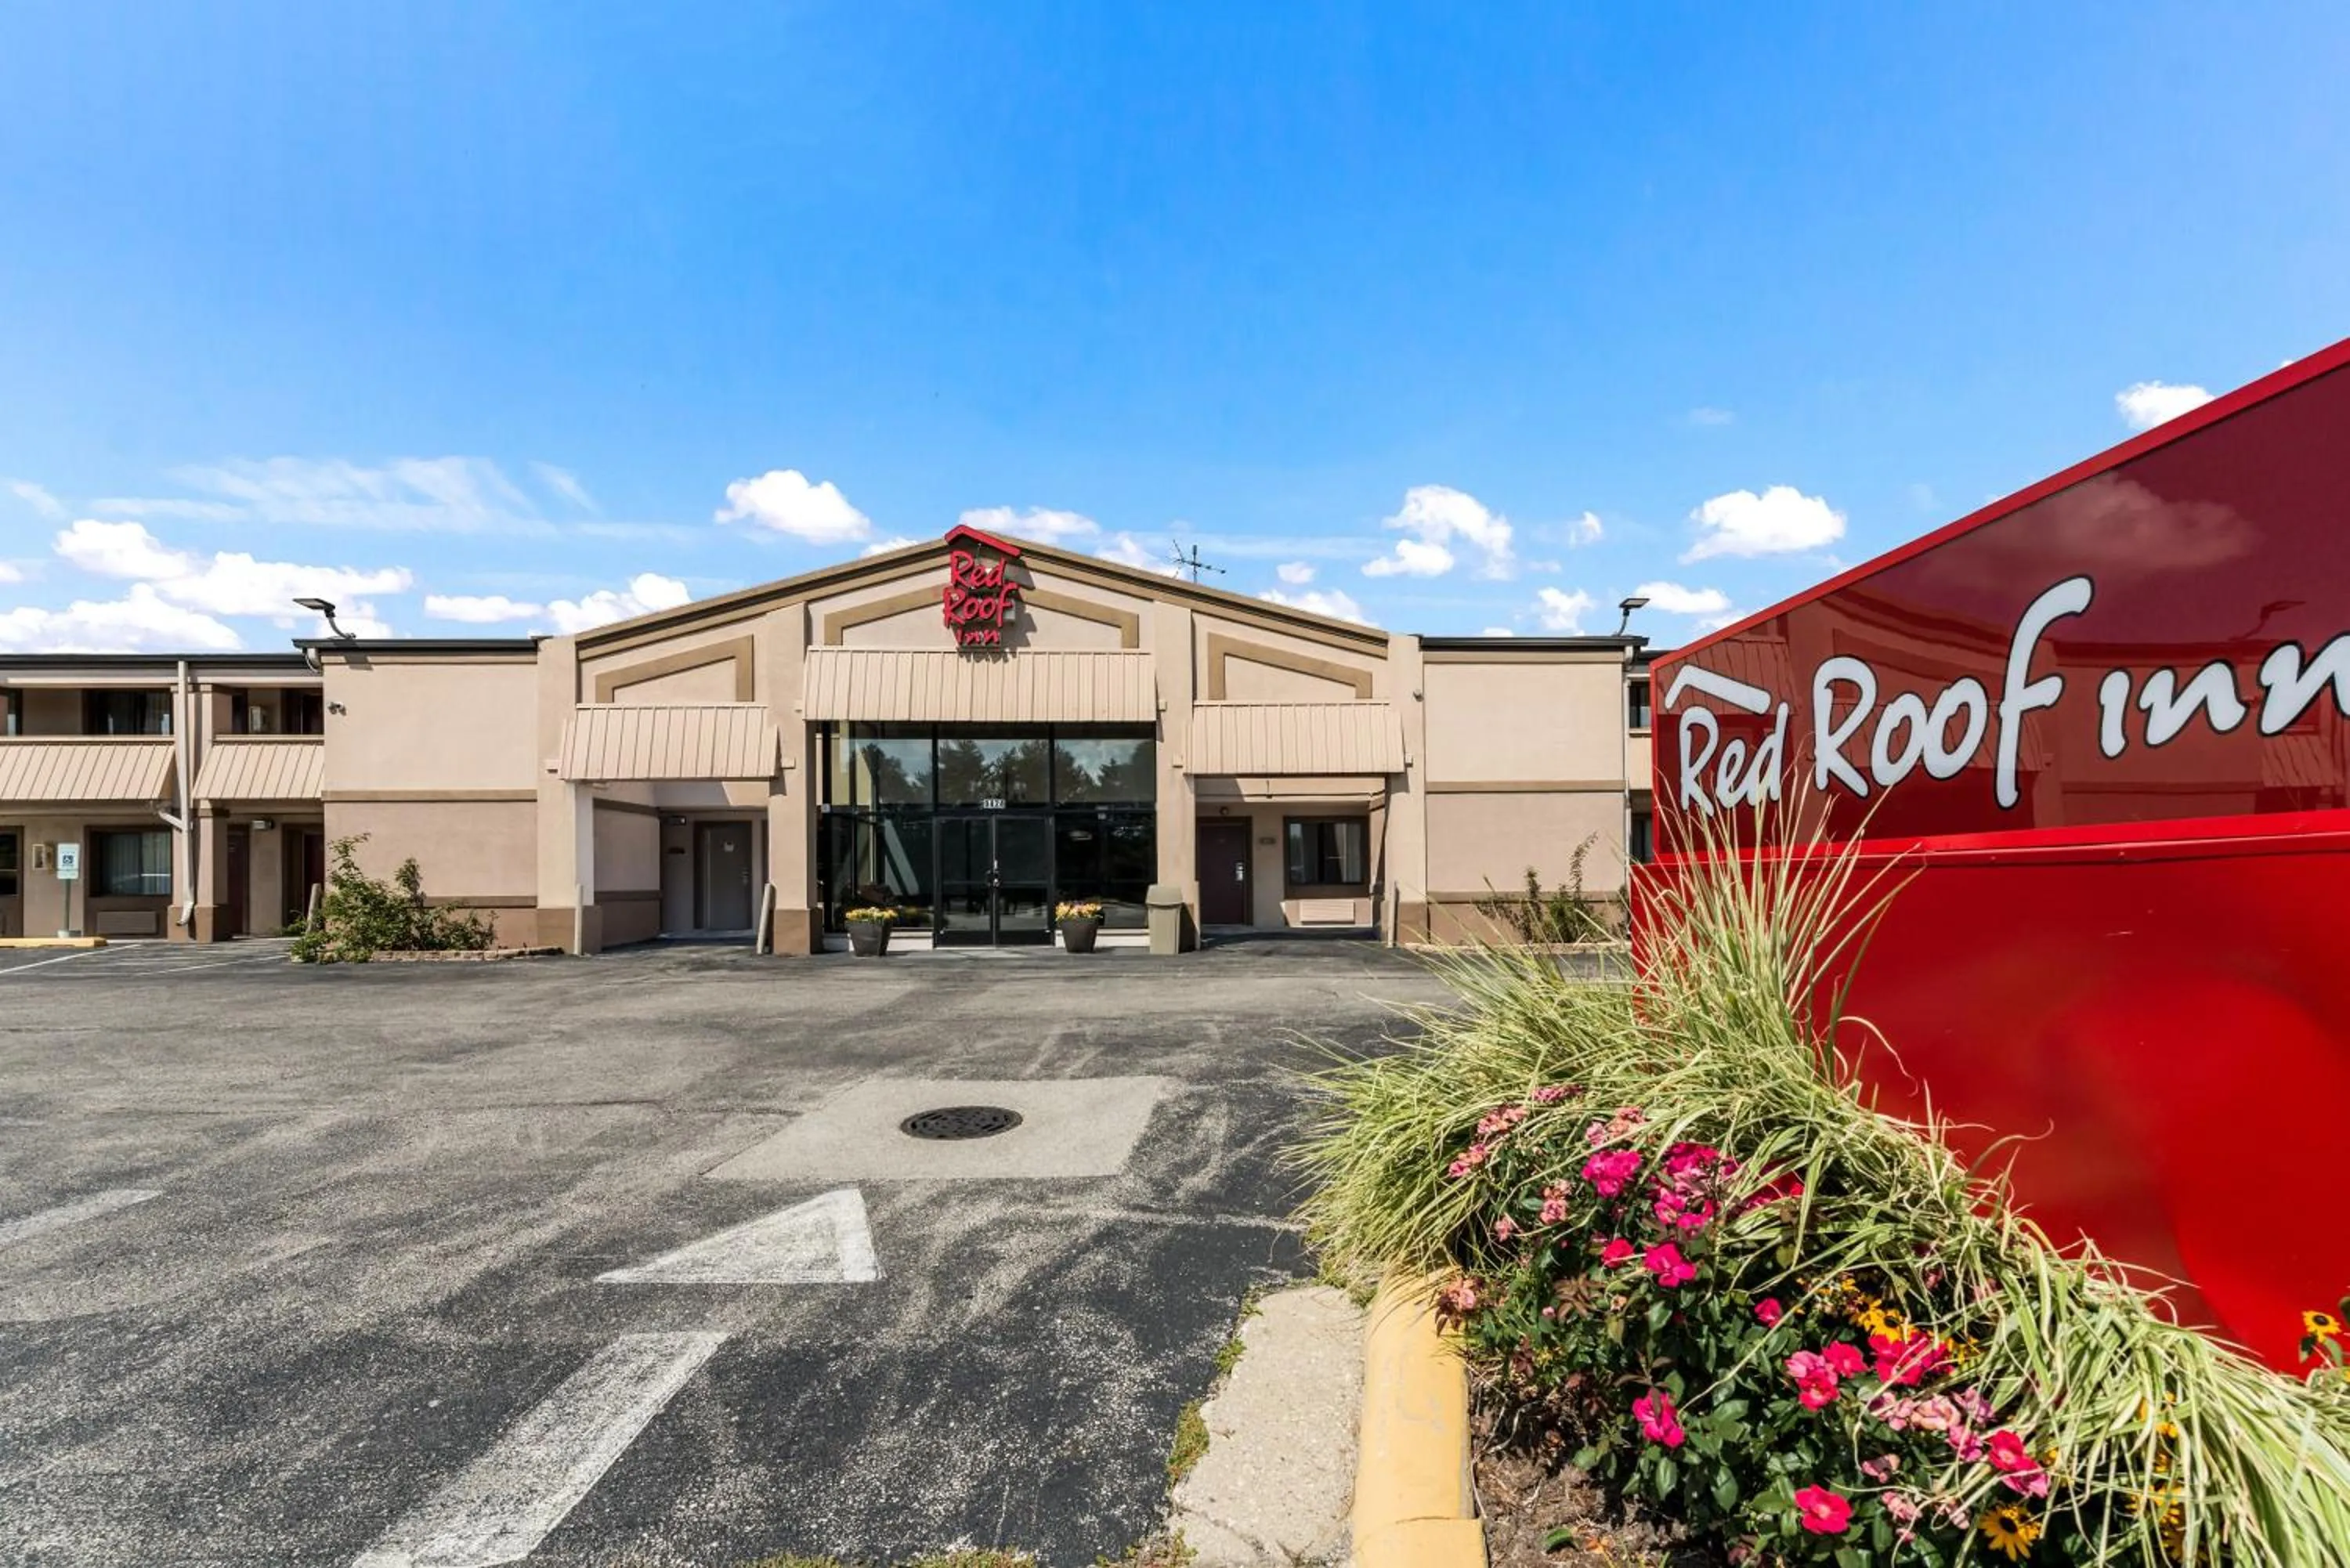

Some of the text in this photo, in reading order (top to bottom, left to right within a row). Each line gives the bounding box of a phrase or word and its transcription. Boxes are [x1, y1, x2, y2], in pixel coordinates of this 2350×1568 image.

[950, 551, 1007, 587] Red
[943, 580, 1019, 628] Roof
[1679, 706, 1789, 817] Red
[1813, 574, 2094, 808] Roof
